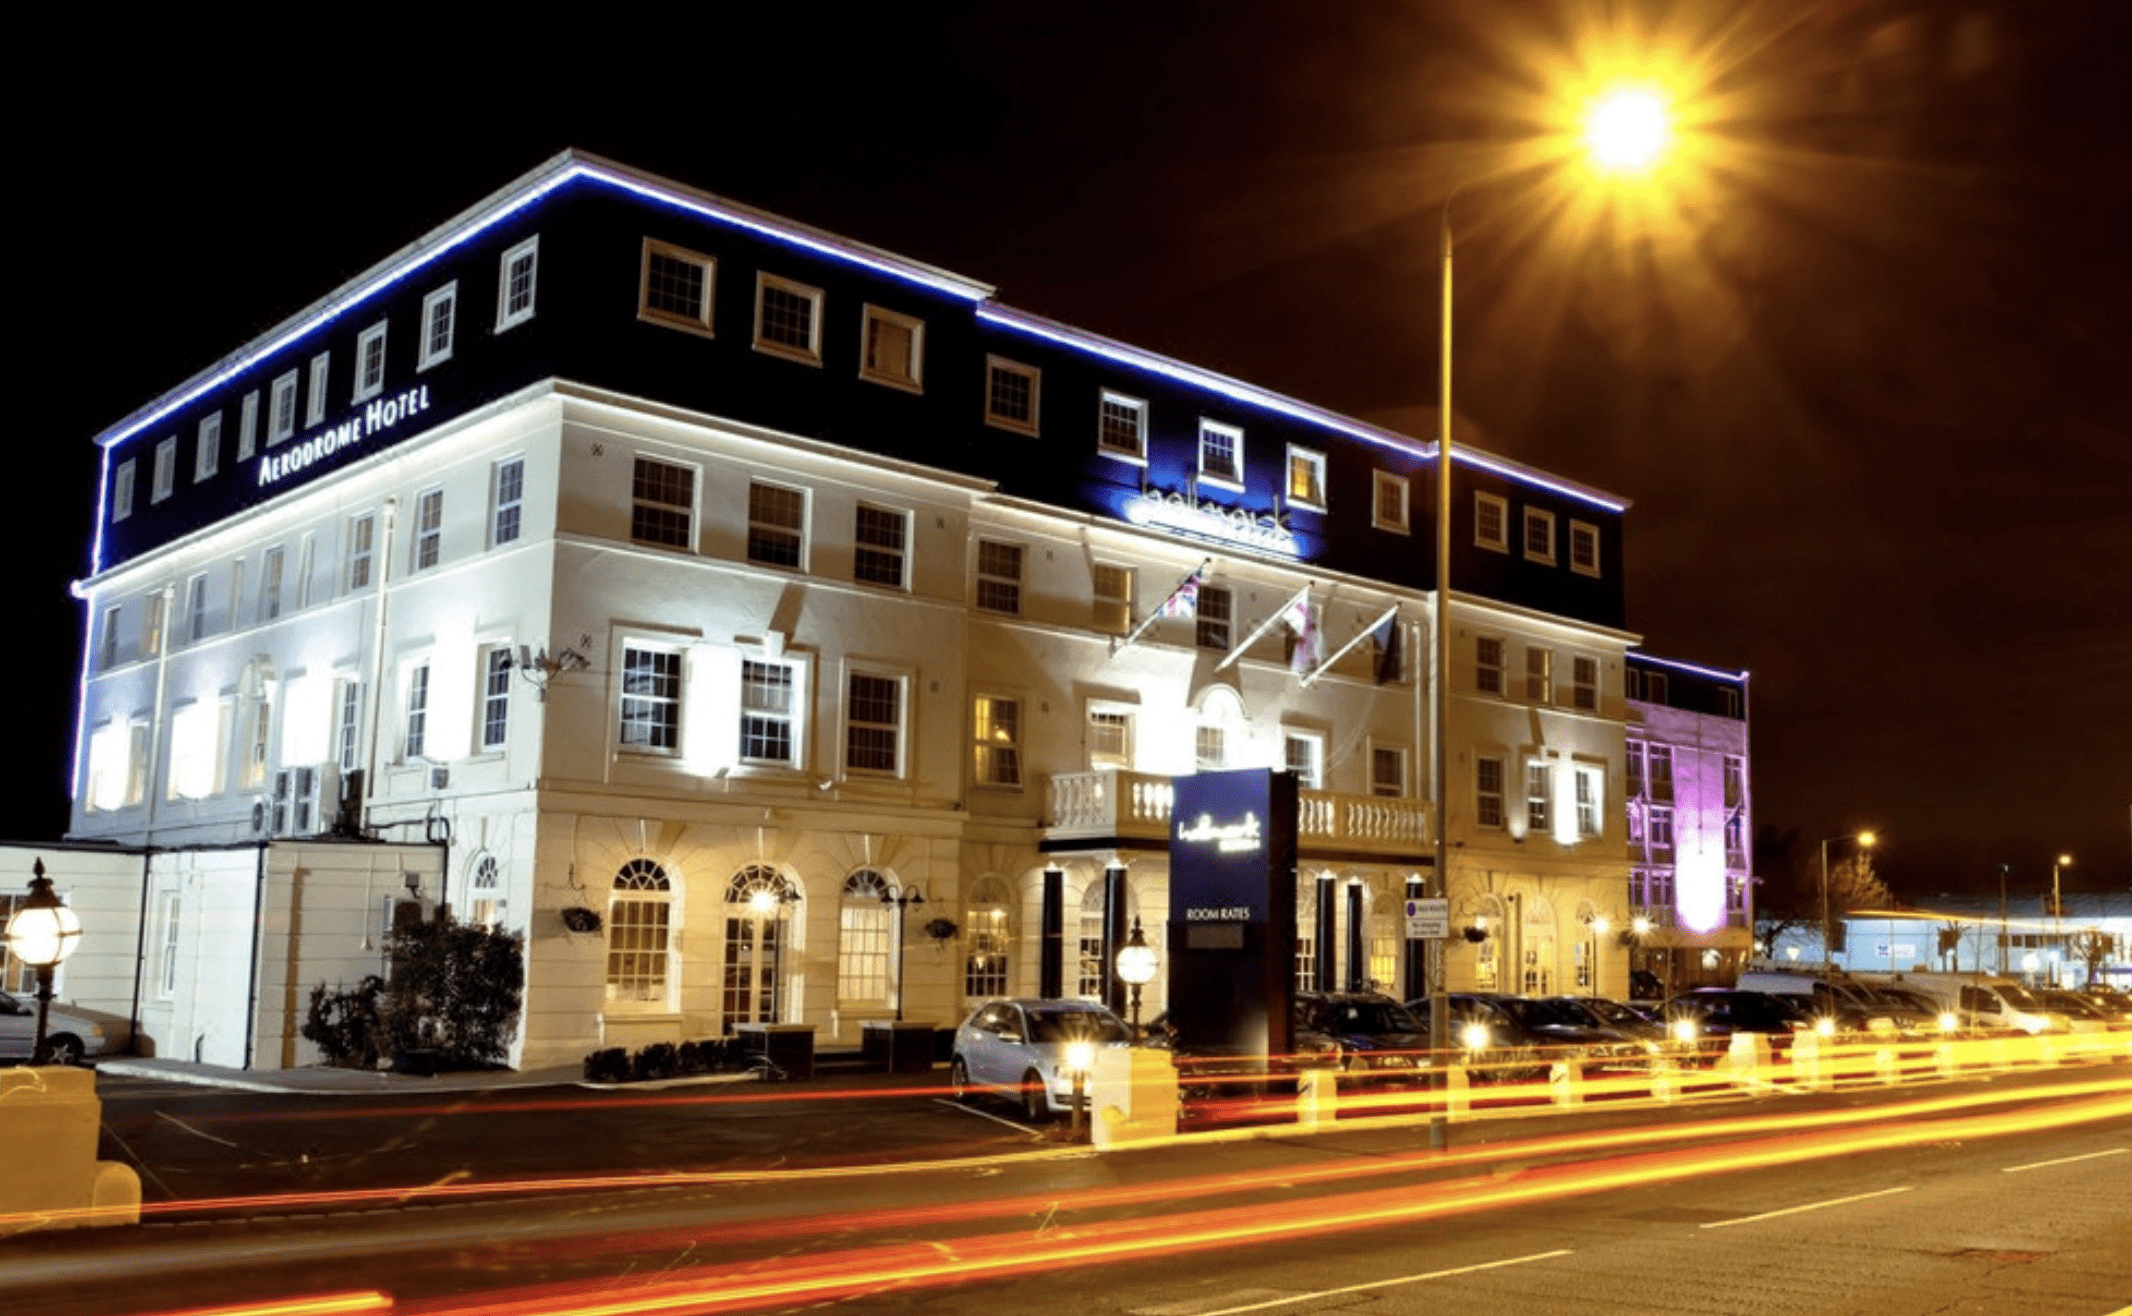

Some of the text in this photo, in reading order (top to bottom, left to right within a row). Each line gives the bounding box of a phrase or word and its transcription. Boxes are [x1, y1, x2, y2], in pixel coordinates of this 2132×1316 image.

[258, 384, 431, 487] AERODROME HOTEL
[1186, 906, 1251, 921] ROOM RATES
